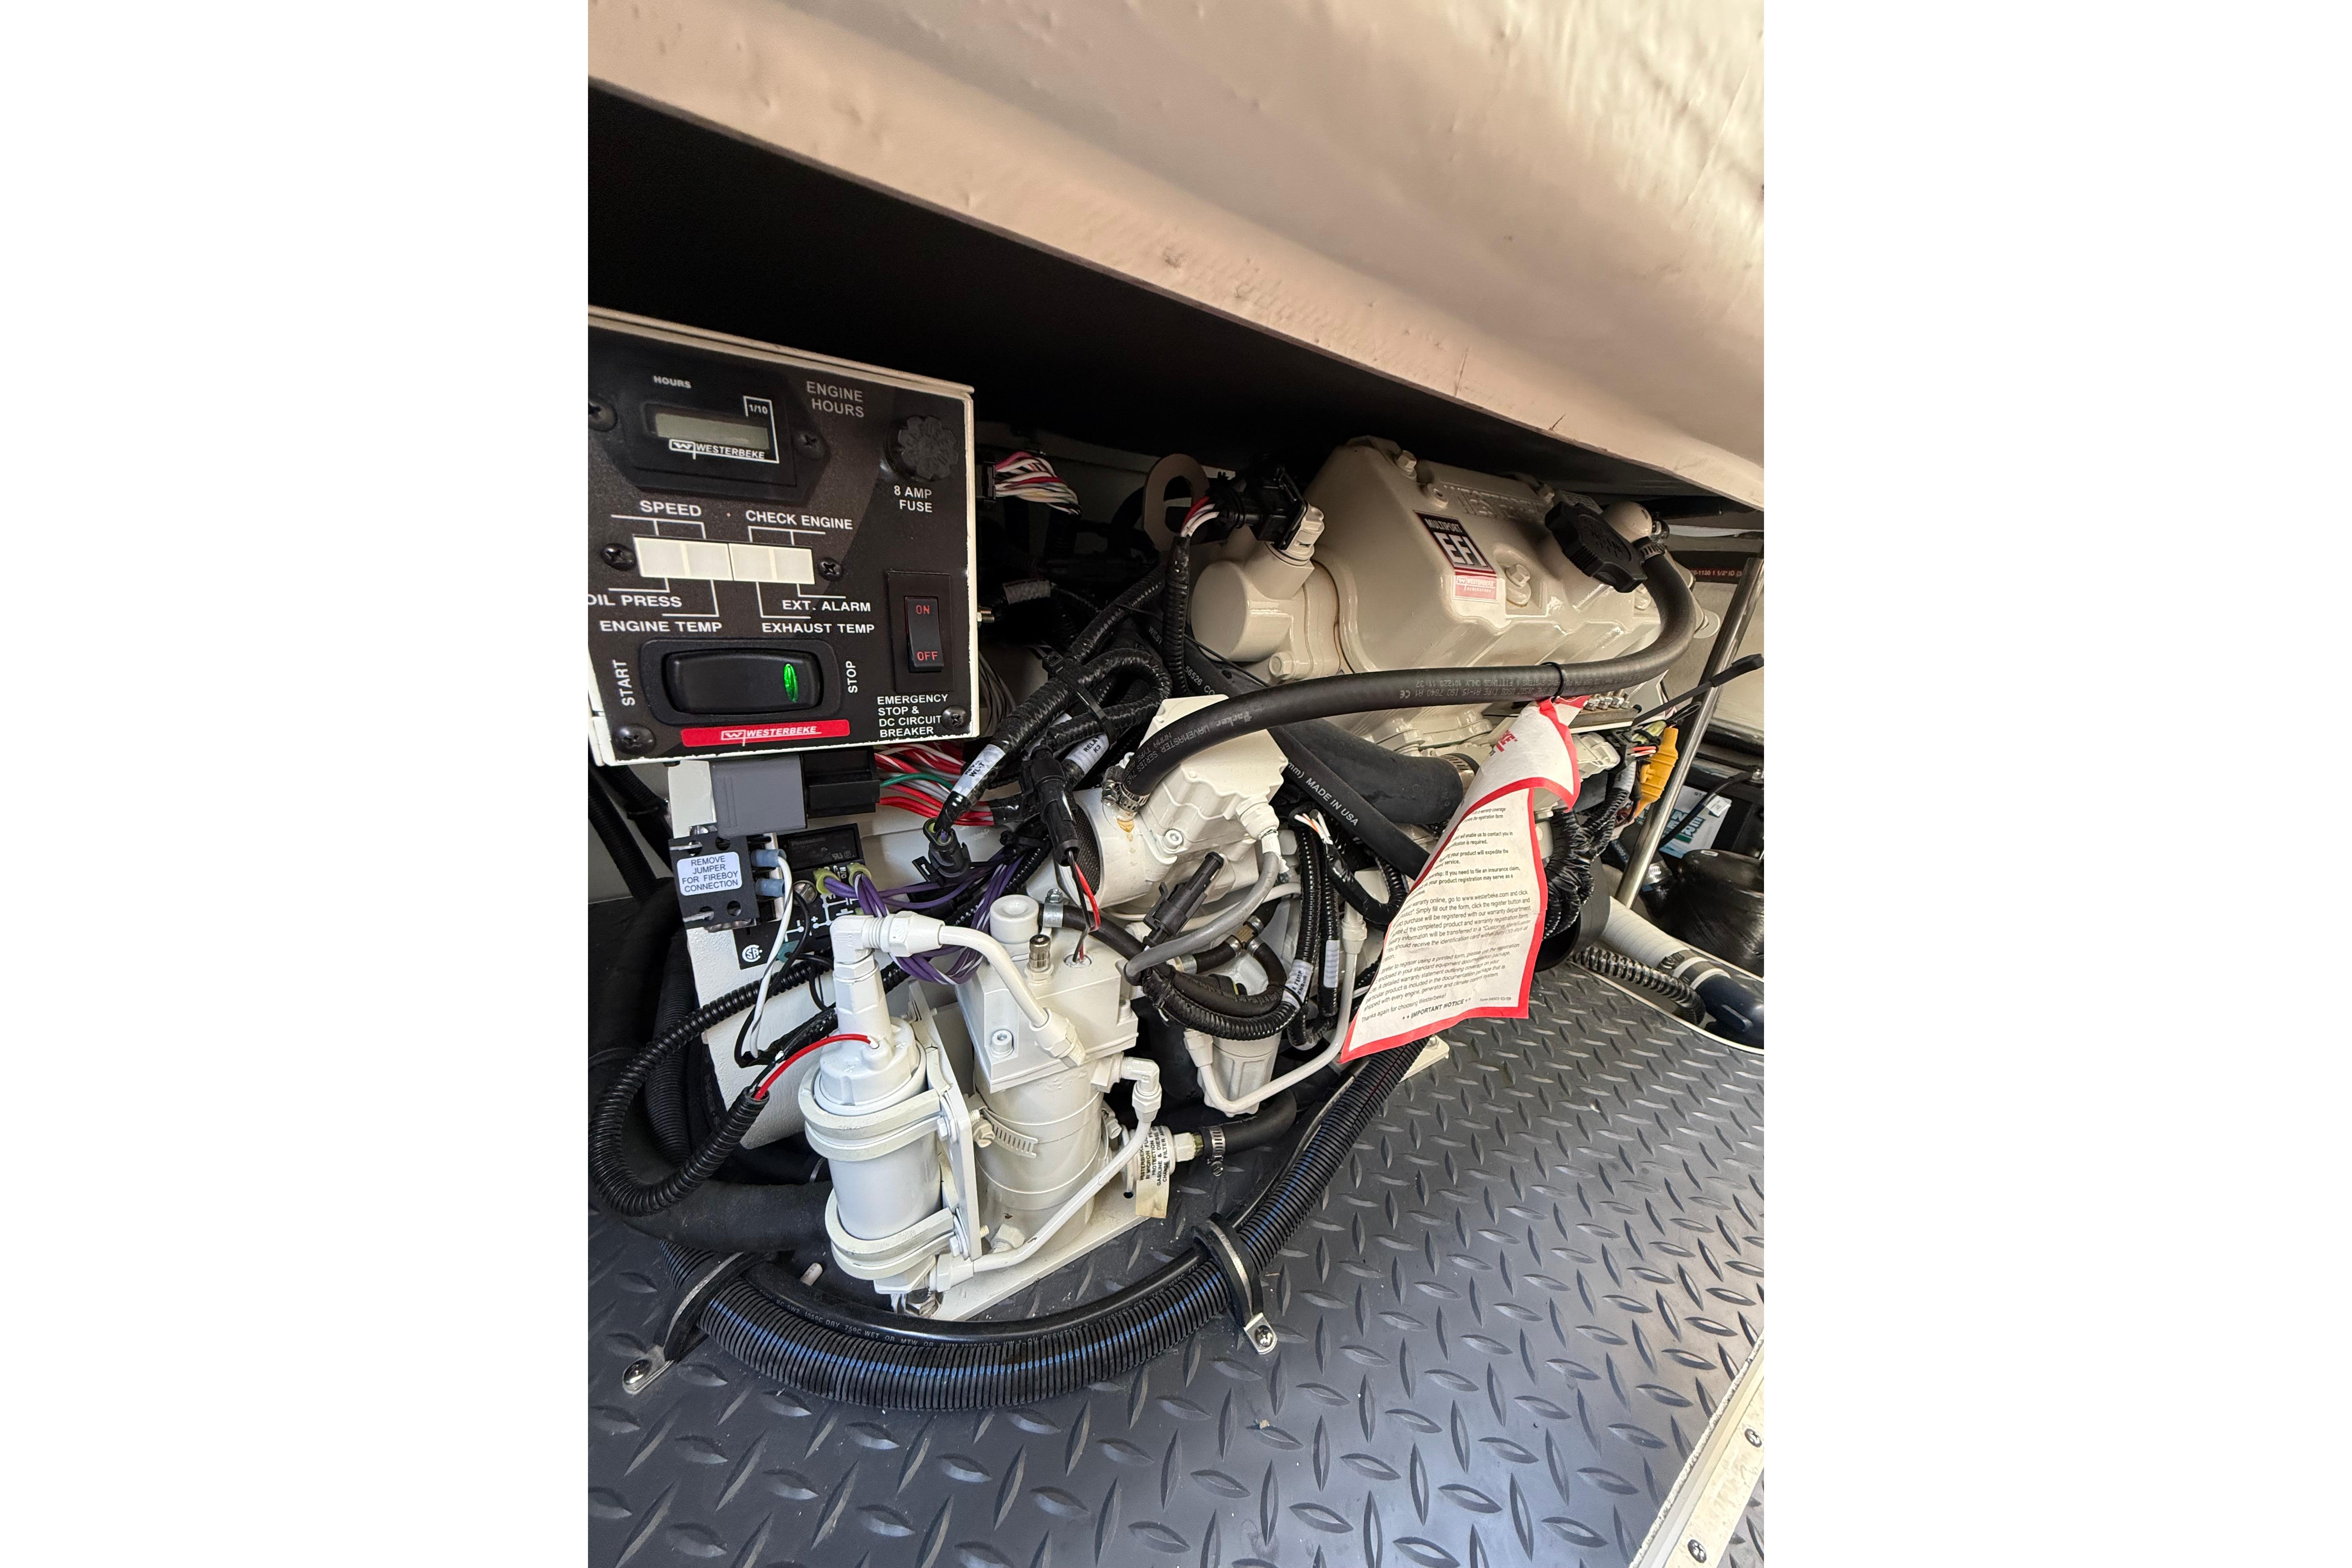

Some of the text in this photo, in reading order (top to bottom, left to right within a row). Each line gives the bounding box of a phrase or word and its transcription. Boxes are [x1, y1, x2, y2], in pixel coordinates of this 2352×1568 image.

[654, 376, 691, 388] HOURS
[807, 381, 863, 403] ENGINE
[749, 404, 768, 414] 1/10
[812, 399, 864, 417] HOURS
[696, 444, 765, 459] WESTERBEKE
[894, 486, 932, 499] 8 AMP
[640, 500, 702, 516] SPEED
[900, 500, 933, 513] FUSE
[746, 510, 853, 529] CHECK ENGINE
[1424, 518, 1463, 532] MULTIPORT
[1434, 532, 1488, 567] EFI
[622, 595, 682, 607] PRESS
[782, 600, 871, 612] EXT. ALARM
[916, 606, 930, 614] ON
[600, 621, 722, 632] ENGINE TEMP
[762, 623, 875, 634] EXHAUST TEMP
[917, 651, 938, 661] OFF
[613, 660, 635, 706] START
[845, 661, 858, 693] STOP
[877, 694, 948, 705] EMERGENCY
[878, 707, 908, 716] STOP
[878, 715, 942, 727] DC CIRCUIT
[1216, 711, 1252, 727] Parker
[746, 726, 817, 737] WESTERBEKE
[879, 726, 934, 738] BREAKER
[1083, 737, 1100, 753] RELAY
[1160, 725, 1210, 752] WAVEMASTER
[1137, 732, 1172, 761] NMMA TYPE
[1137, 751, 1158, 772] SERIES
[1306, 778, 1332, 801] MADE
[1330, 799, 1342, 810] IN
[1340, 808, 1358, 826] USA
[691, 856, 725, 866] REMOVE
[693, 864, 726, 874] JUMPER
[682, 871, 738, 884] FOR FIREBOY
[684, 879, 738, 892] CONNECTION
[1462, 892, 1509, 901] www.westerbeke.com
[1404, 917, 1423, 926] purchase
[1417, 922, 1442, 931] completed
[1443, 921, 1463, 929] product
[1494, 915, 1518, 923] registration
[1402, 933, 1428, 941] information
[1362, 1013, 1376, 1022] Thanks
[1377, 1008, 1390, 1017] again
[1398, 1001, 1418, 1010] choosing
[1419, 993, 1446, 1004] Westerbeke!
[1411, 999, 1465, 1018] IMPORTANT NOTICE
[826, 1319, 840, 1327] DRY
[865, 1330, 880, 1339] WET
